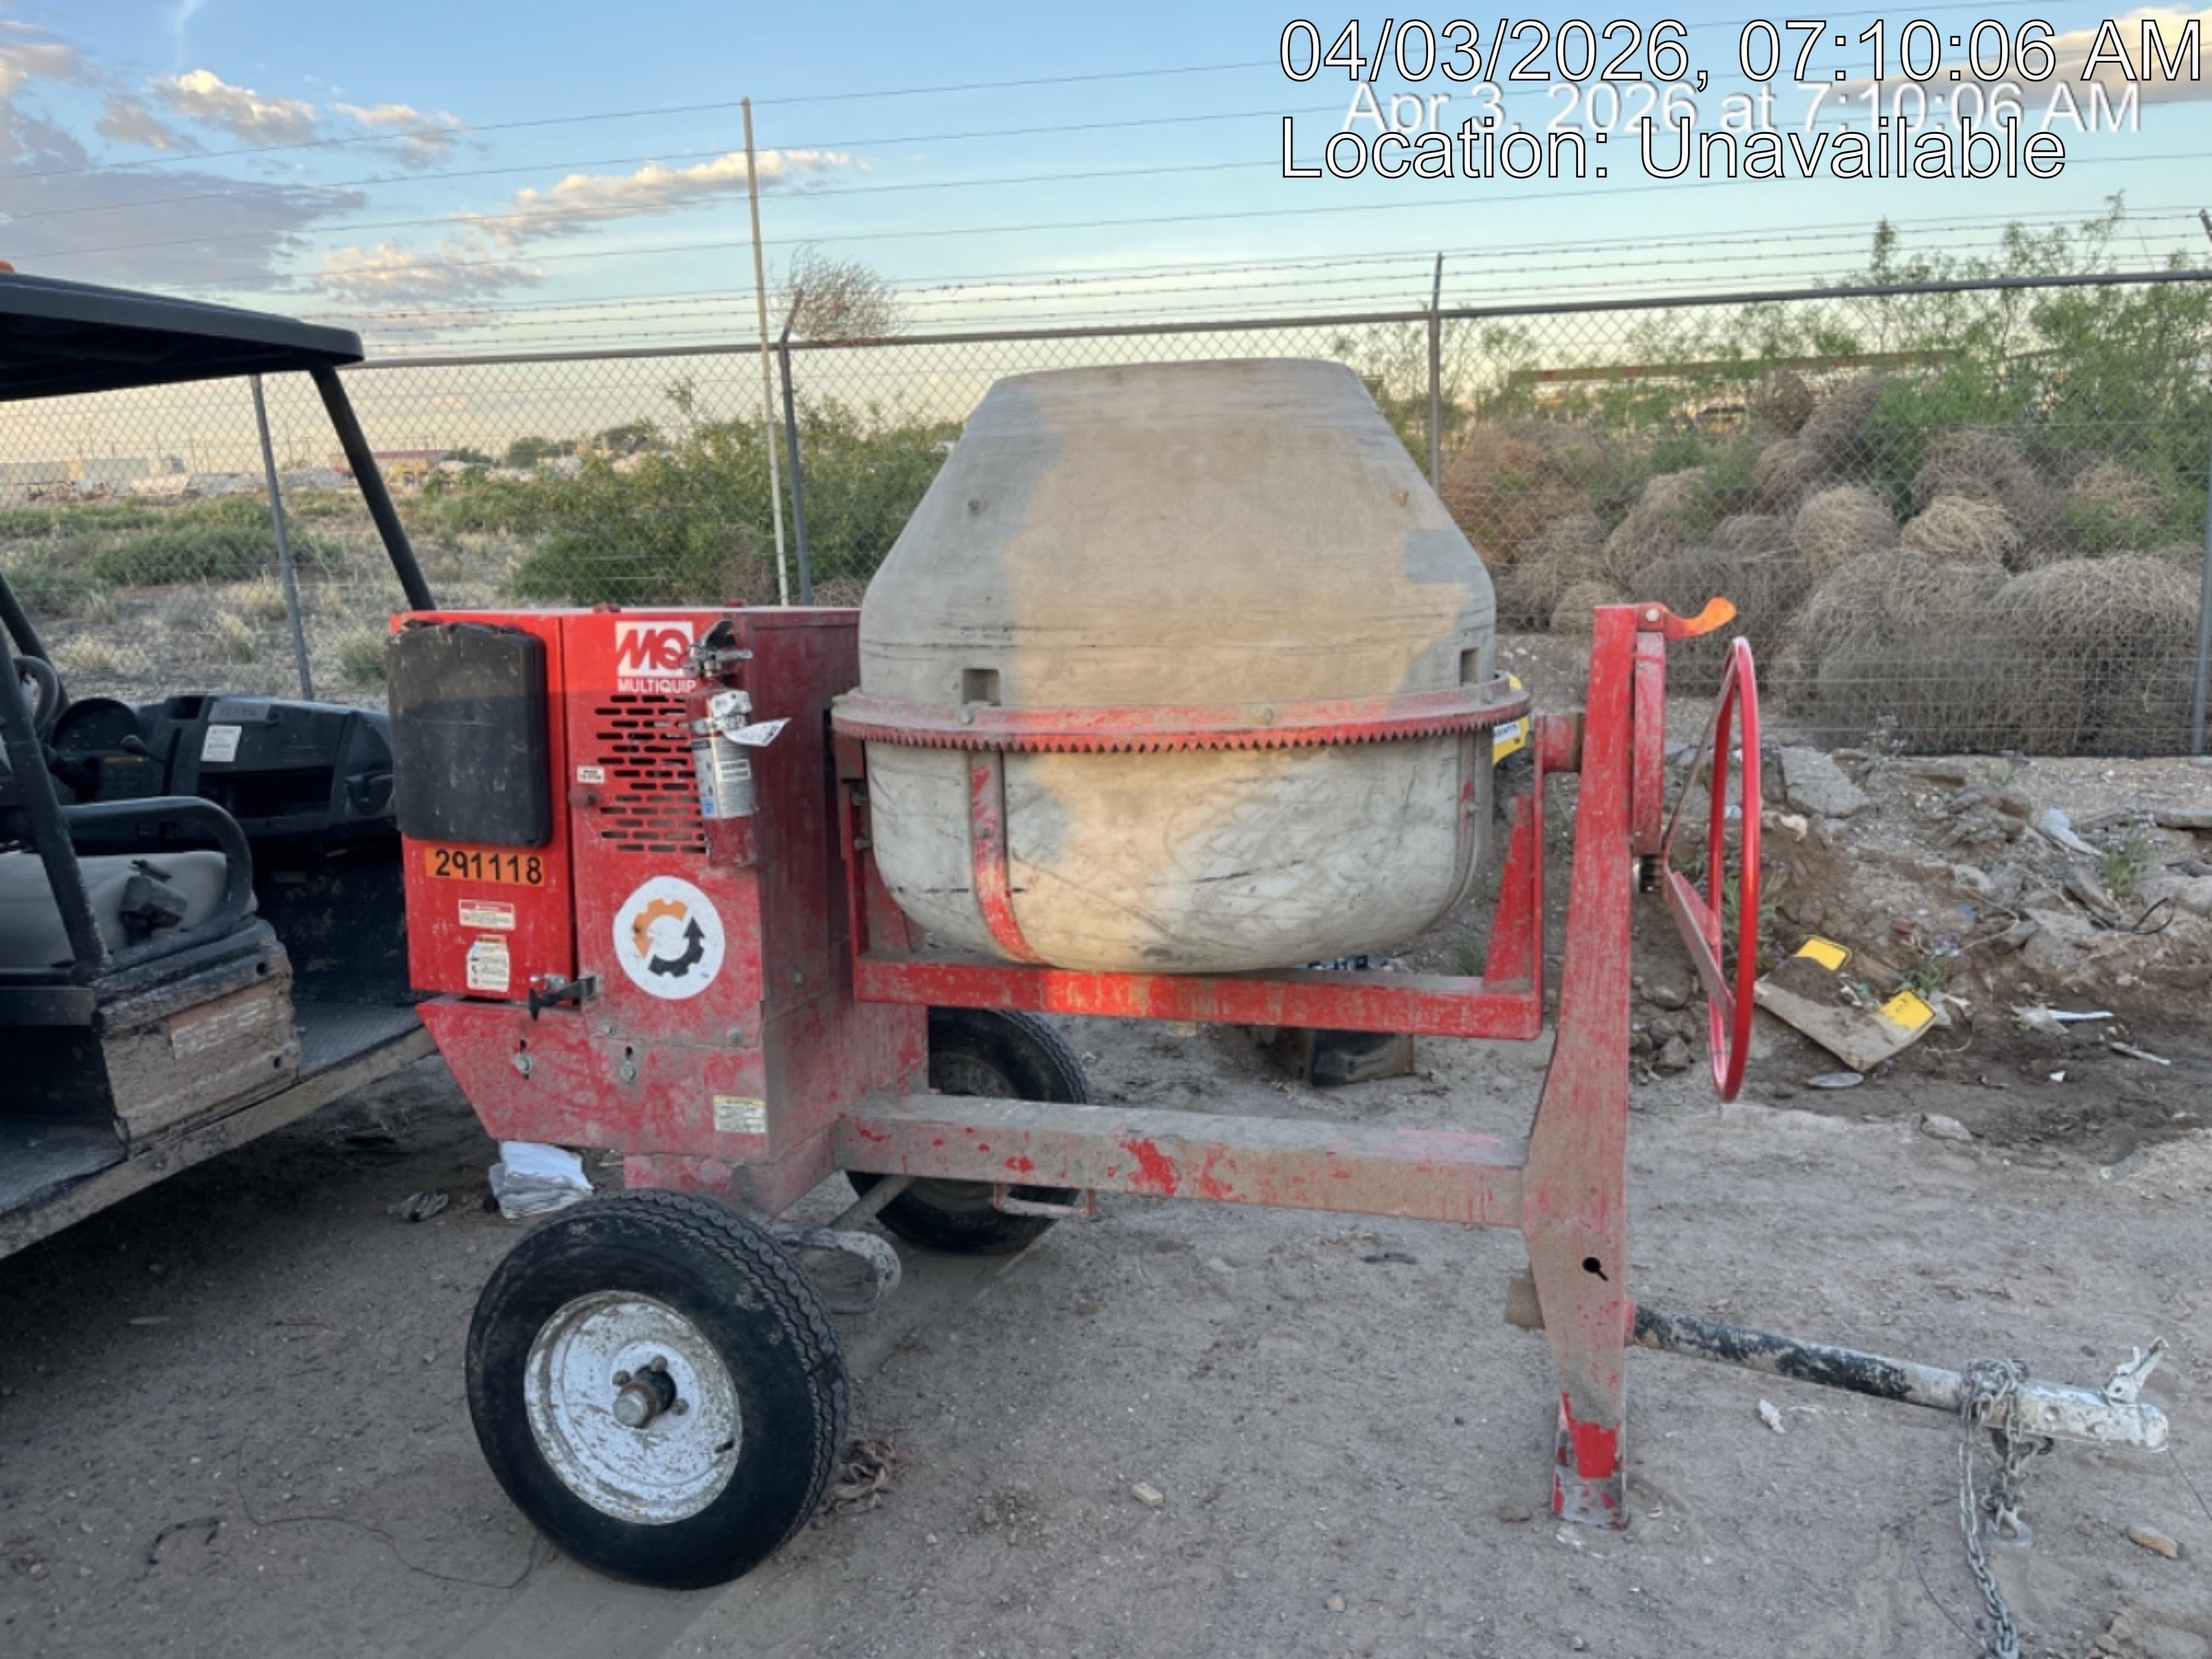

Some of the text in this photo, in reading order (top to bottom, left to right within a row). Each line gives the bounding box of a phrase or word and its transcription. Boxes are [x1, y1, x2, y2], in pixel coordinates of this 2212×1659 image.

[615, 629, 689, 670] MQ
[618, 677, 696, 694] MULTIQUIP
[435, 849, 542, 885] 291118
